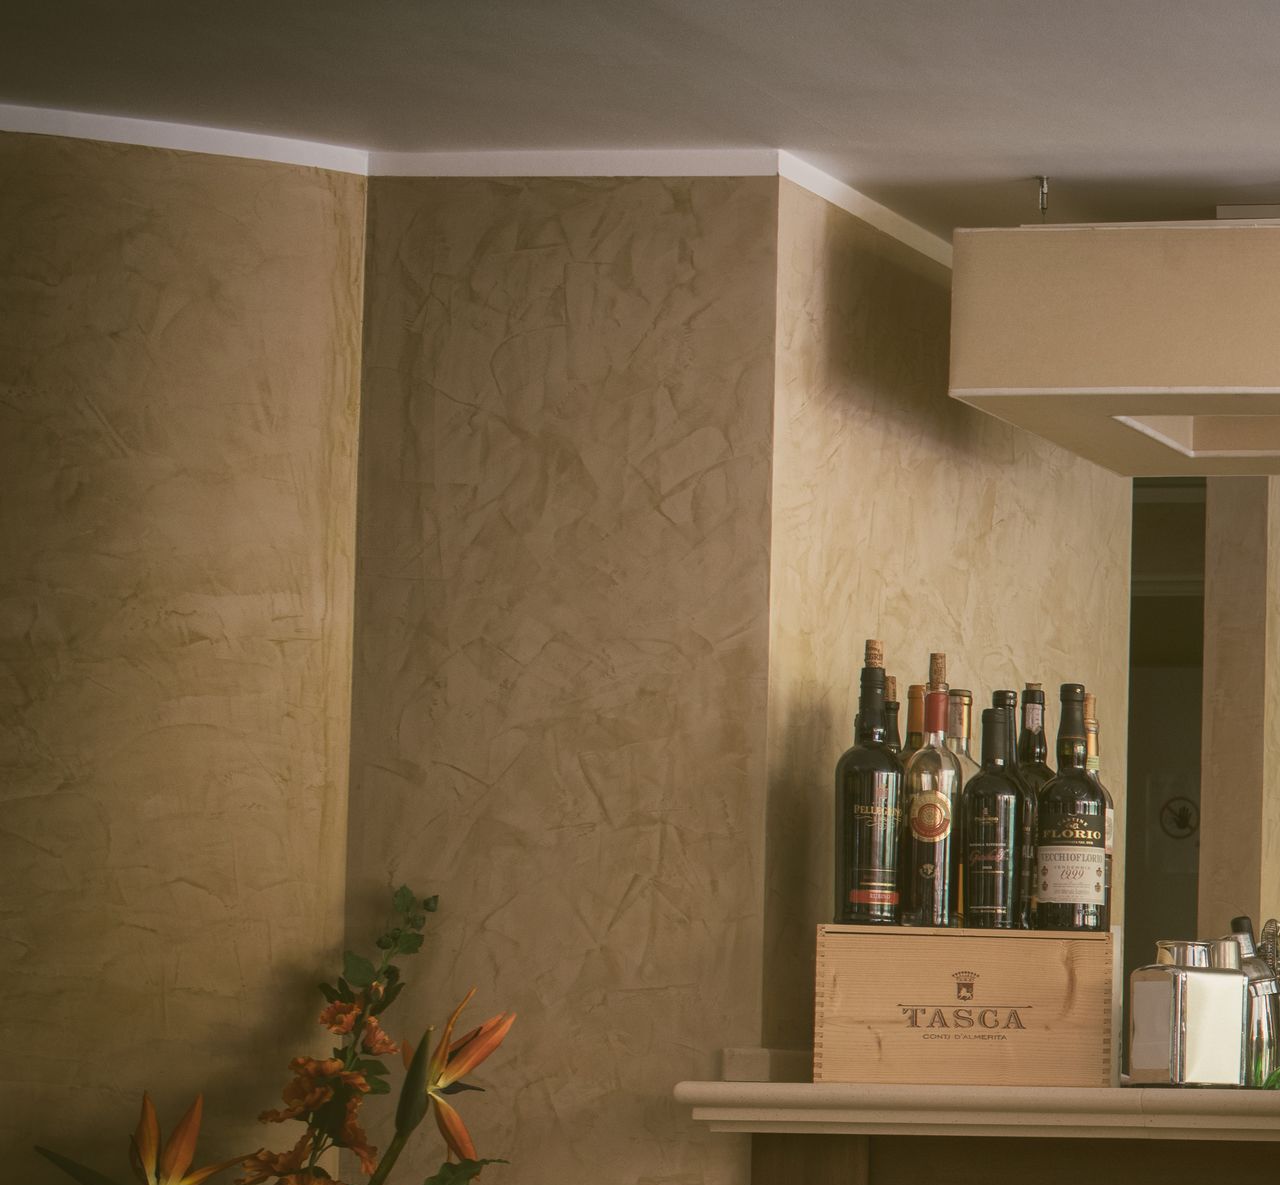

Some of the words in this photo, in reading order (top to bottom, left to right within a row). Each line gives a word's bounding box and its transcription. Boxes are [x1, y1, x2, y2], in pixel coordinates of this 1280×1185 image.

[1043, 829, 1101, 840] FLORIO
[902, 1008, 1026, 1029] TASCA
[954, 1033, 1008, 1041] D'ALMERITA
